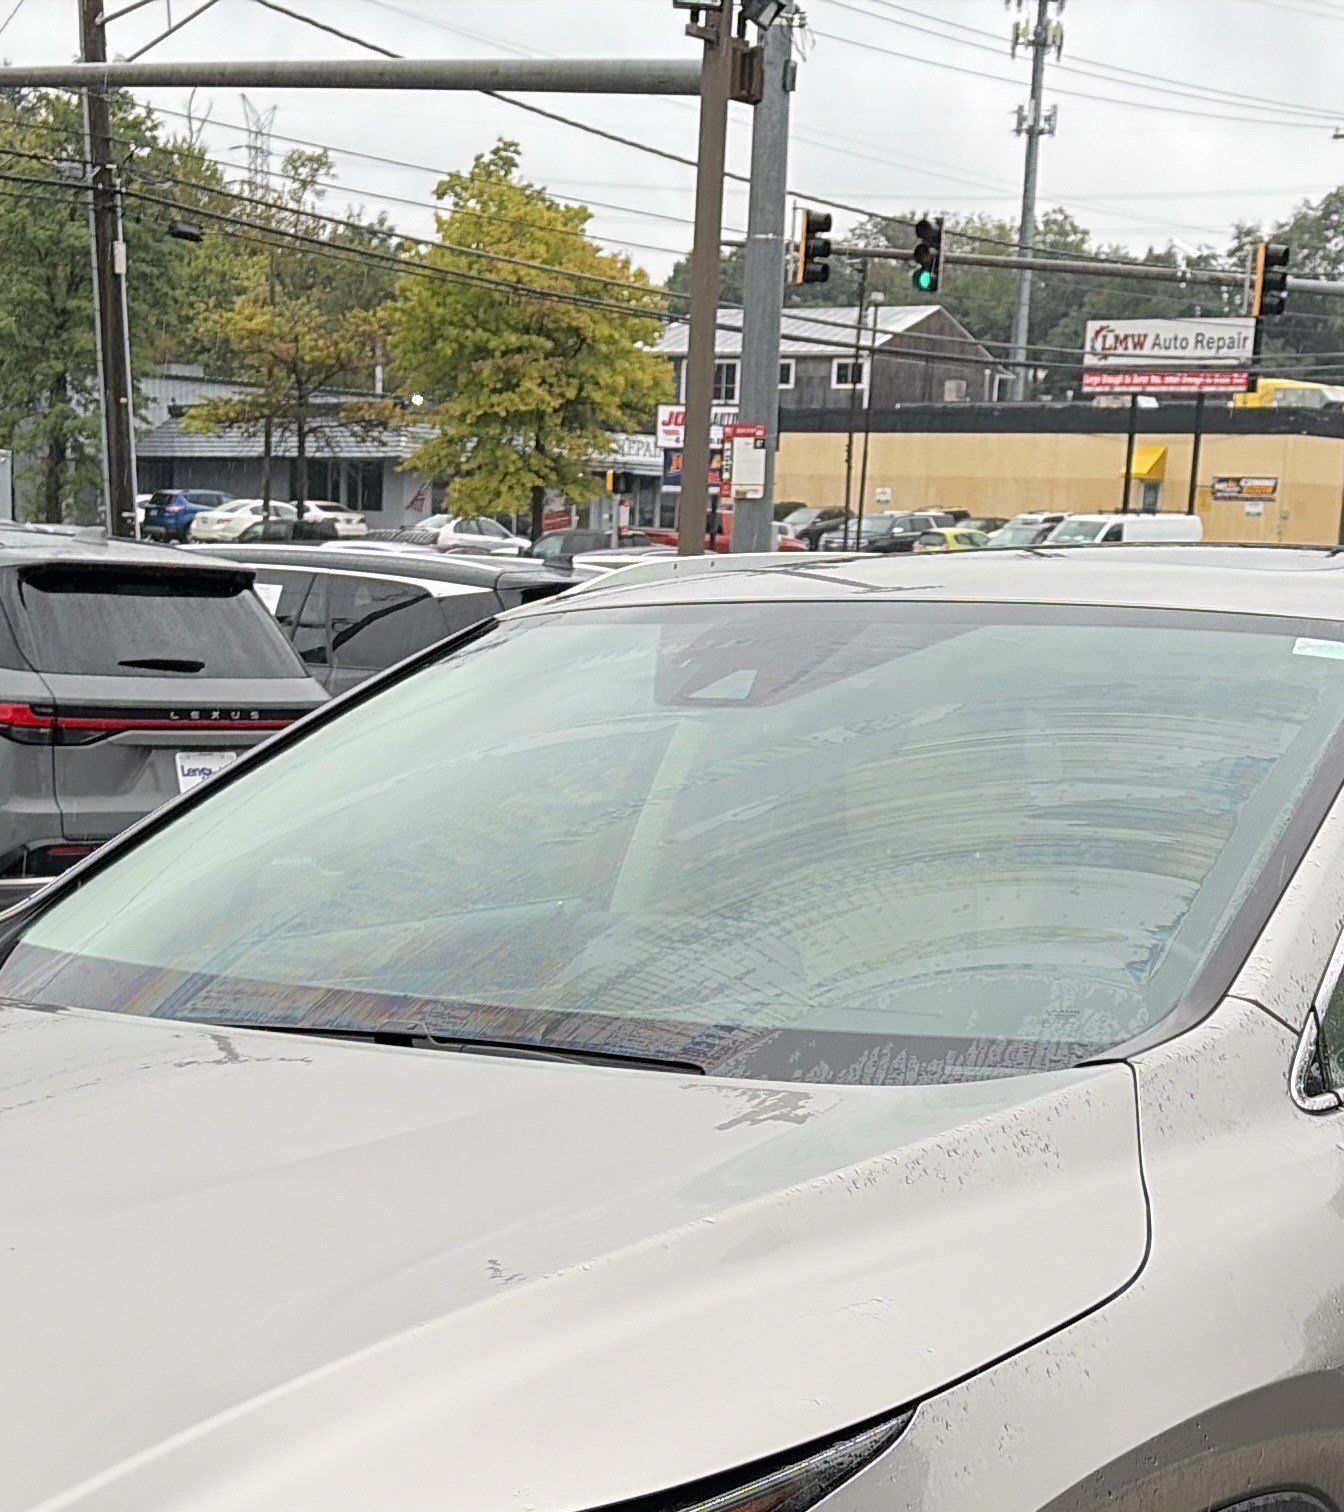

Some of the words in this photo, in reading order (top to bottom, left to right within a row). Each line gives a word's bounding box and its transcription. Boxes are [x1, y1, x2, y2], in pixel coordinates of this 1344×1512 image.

[1100, 332, 1149, 352] LMW
[1151, 331, 1190, 351] Auto
[1193, 330, 1250, 354] Repair
[662, 411, 686, 427] JO
[169, 710, 261, 720] LEXUS
